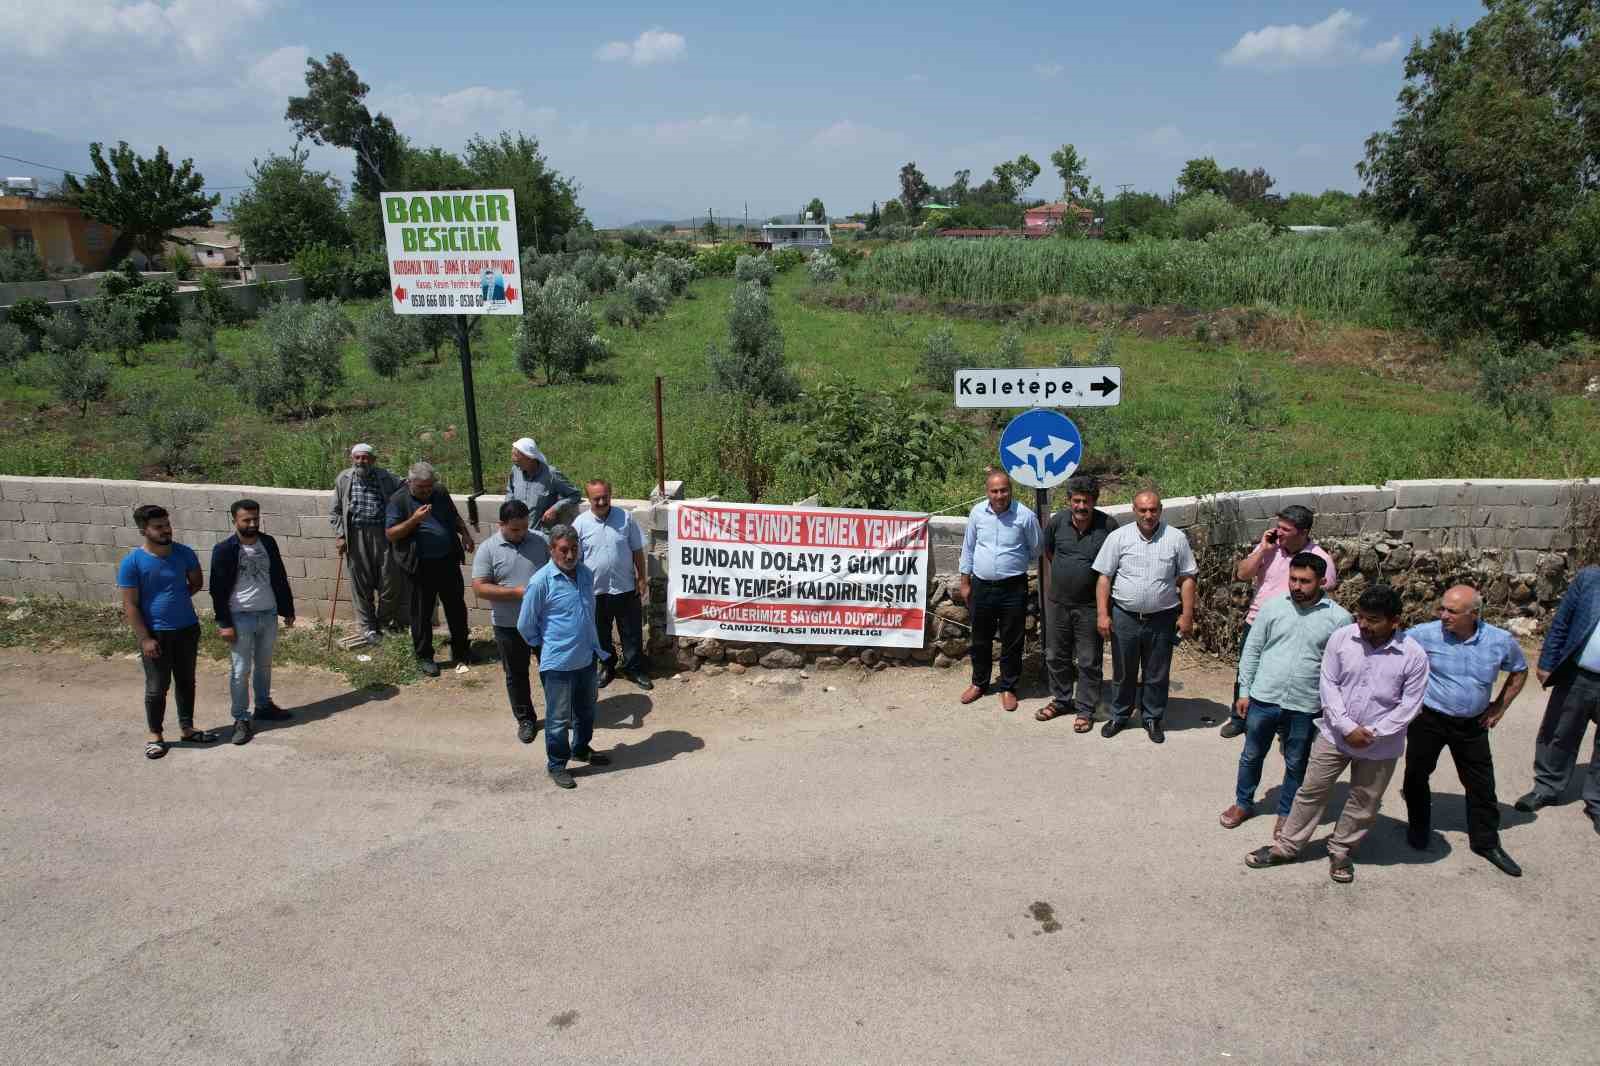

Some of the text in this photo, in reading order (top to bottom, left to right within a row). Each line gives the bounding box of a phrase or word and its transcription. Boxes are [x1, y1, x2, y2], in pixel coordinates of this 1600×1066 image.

[959, 378, 1074, 399] Kaletepe
[681, 510, 740, 540] CENAZE
[806, 516, 859, 545] YEMEK
[681, 546, 919, 575] BUNDAN DOLAYI 3 GÜNLÜK
[681, 570, 730, 595] TAZİYE
[790, 609, 841, 624] SAYGIYLA
[845, 611, 903, 626] DUYRULUR
